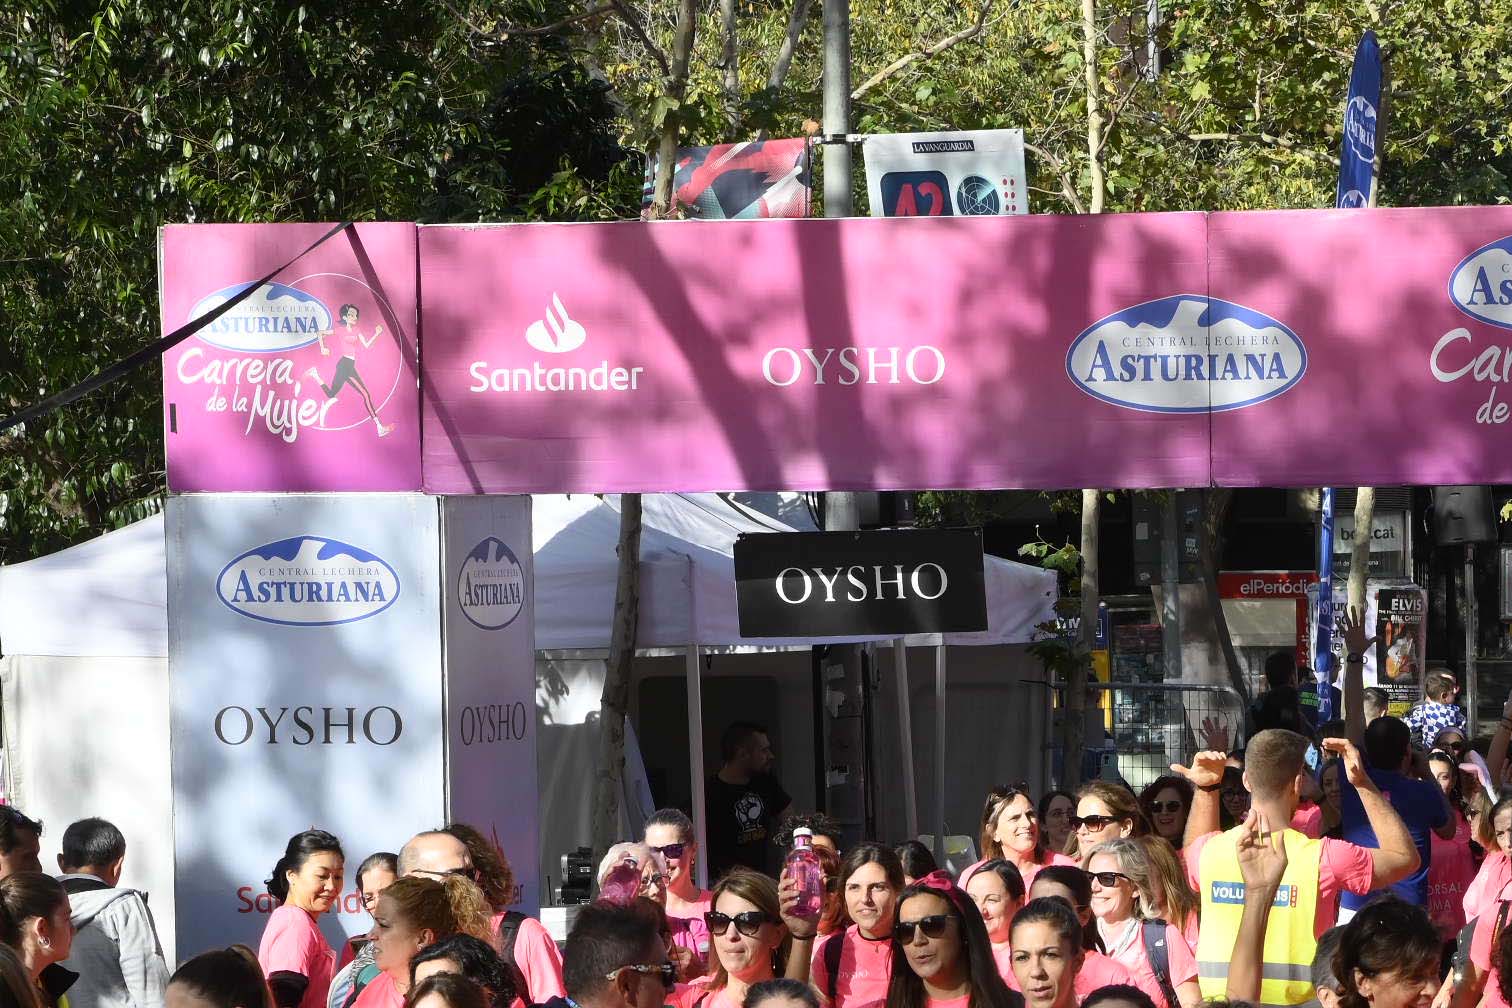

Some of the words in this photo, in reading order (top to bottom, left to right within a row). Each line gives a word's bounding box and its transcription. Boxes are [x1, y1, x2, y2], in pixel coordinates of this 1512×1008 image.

[1122, 336, 1197, 347] CENTRAL
[1204, 335, 1281, 347] LECHERA
[177, 346, 294, 386] Carrera
[469, 360, 643, 393] Santander
[761, 345, 947, 387] OYSHO
[1085, 339, 1289, 383] ASTURIANA
[206, 388, 229, 413] de
[232, 388, 248, 413] la
[245, 381, 339, 443] Mujer
[1476, 386, 1510, 425] de
[231, 569, 387, 604] ASTURIANA
[258, 566, 316, 577] CENTRAL
[323, 566, 380, 577] LECHERA
[463, 571, 522, 608] ASTURIANA
[775, 562, 949, 605] OYSHO
[1391, 598, 1422, 610] ELVIS
[214, 705, 403, 747] OYSHO
[460, 701, 527, 747] OYSHO
[1212, 884, 1289, 902] VOLUIS
